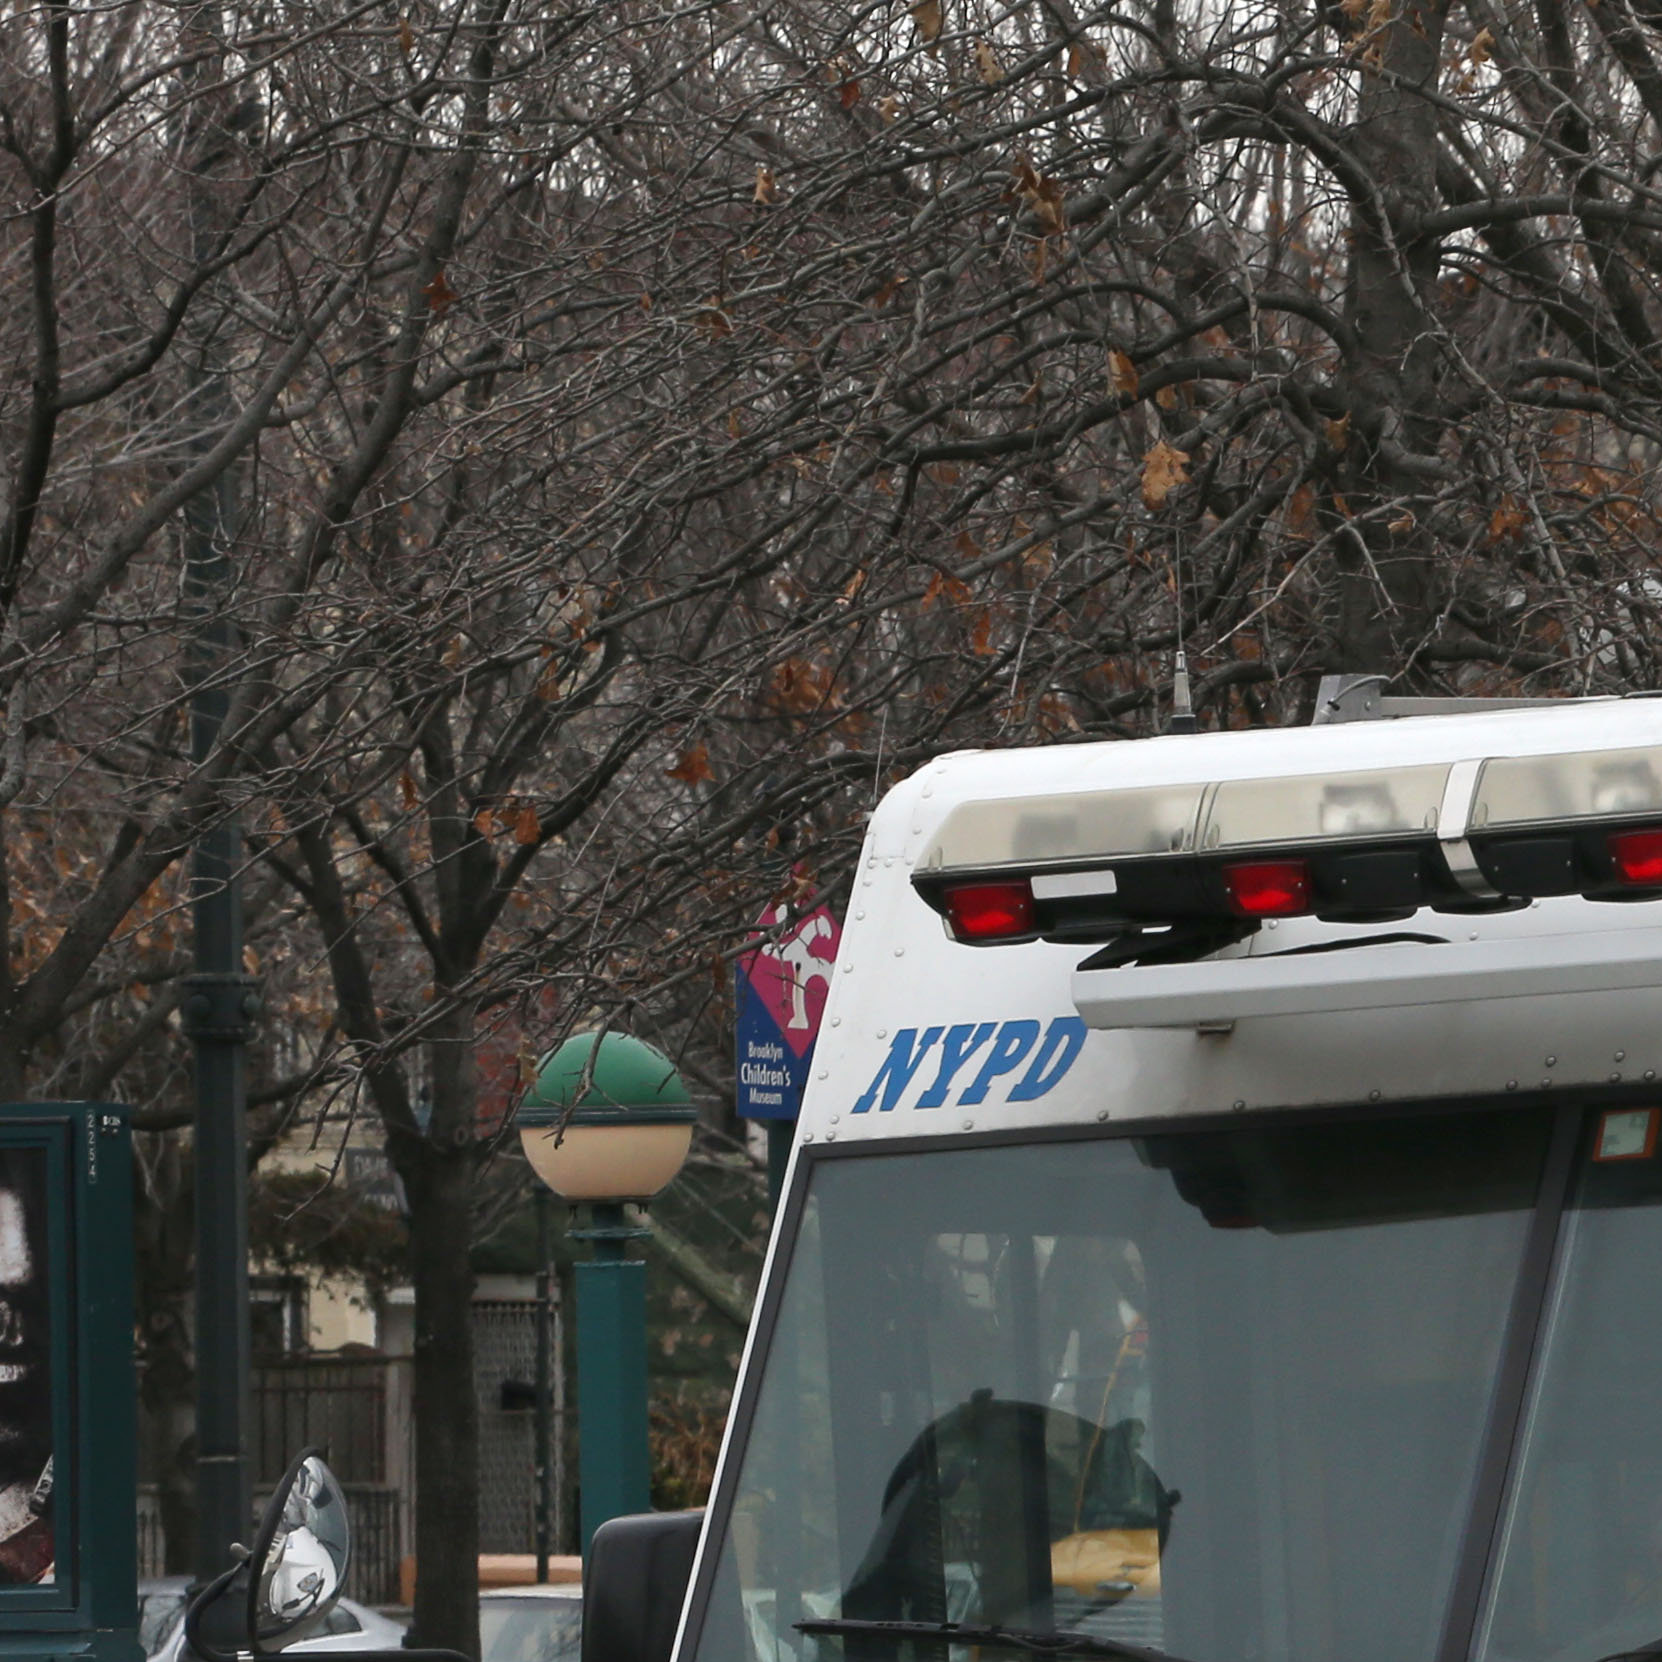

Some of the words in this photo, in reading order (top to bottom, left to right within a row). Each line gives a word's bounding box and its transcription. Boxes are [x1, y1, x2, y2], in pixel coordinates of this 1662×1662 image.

[748, 1041, 784, 1063] Brooklyn
[741, 1062, 792, 1087] Children's
[852, 1016, 1088, 1114] NYPD
[749, 1087, 783, 1105] Museum
